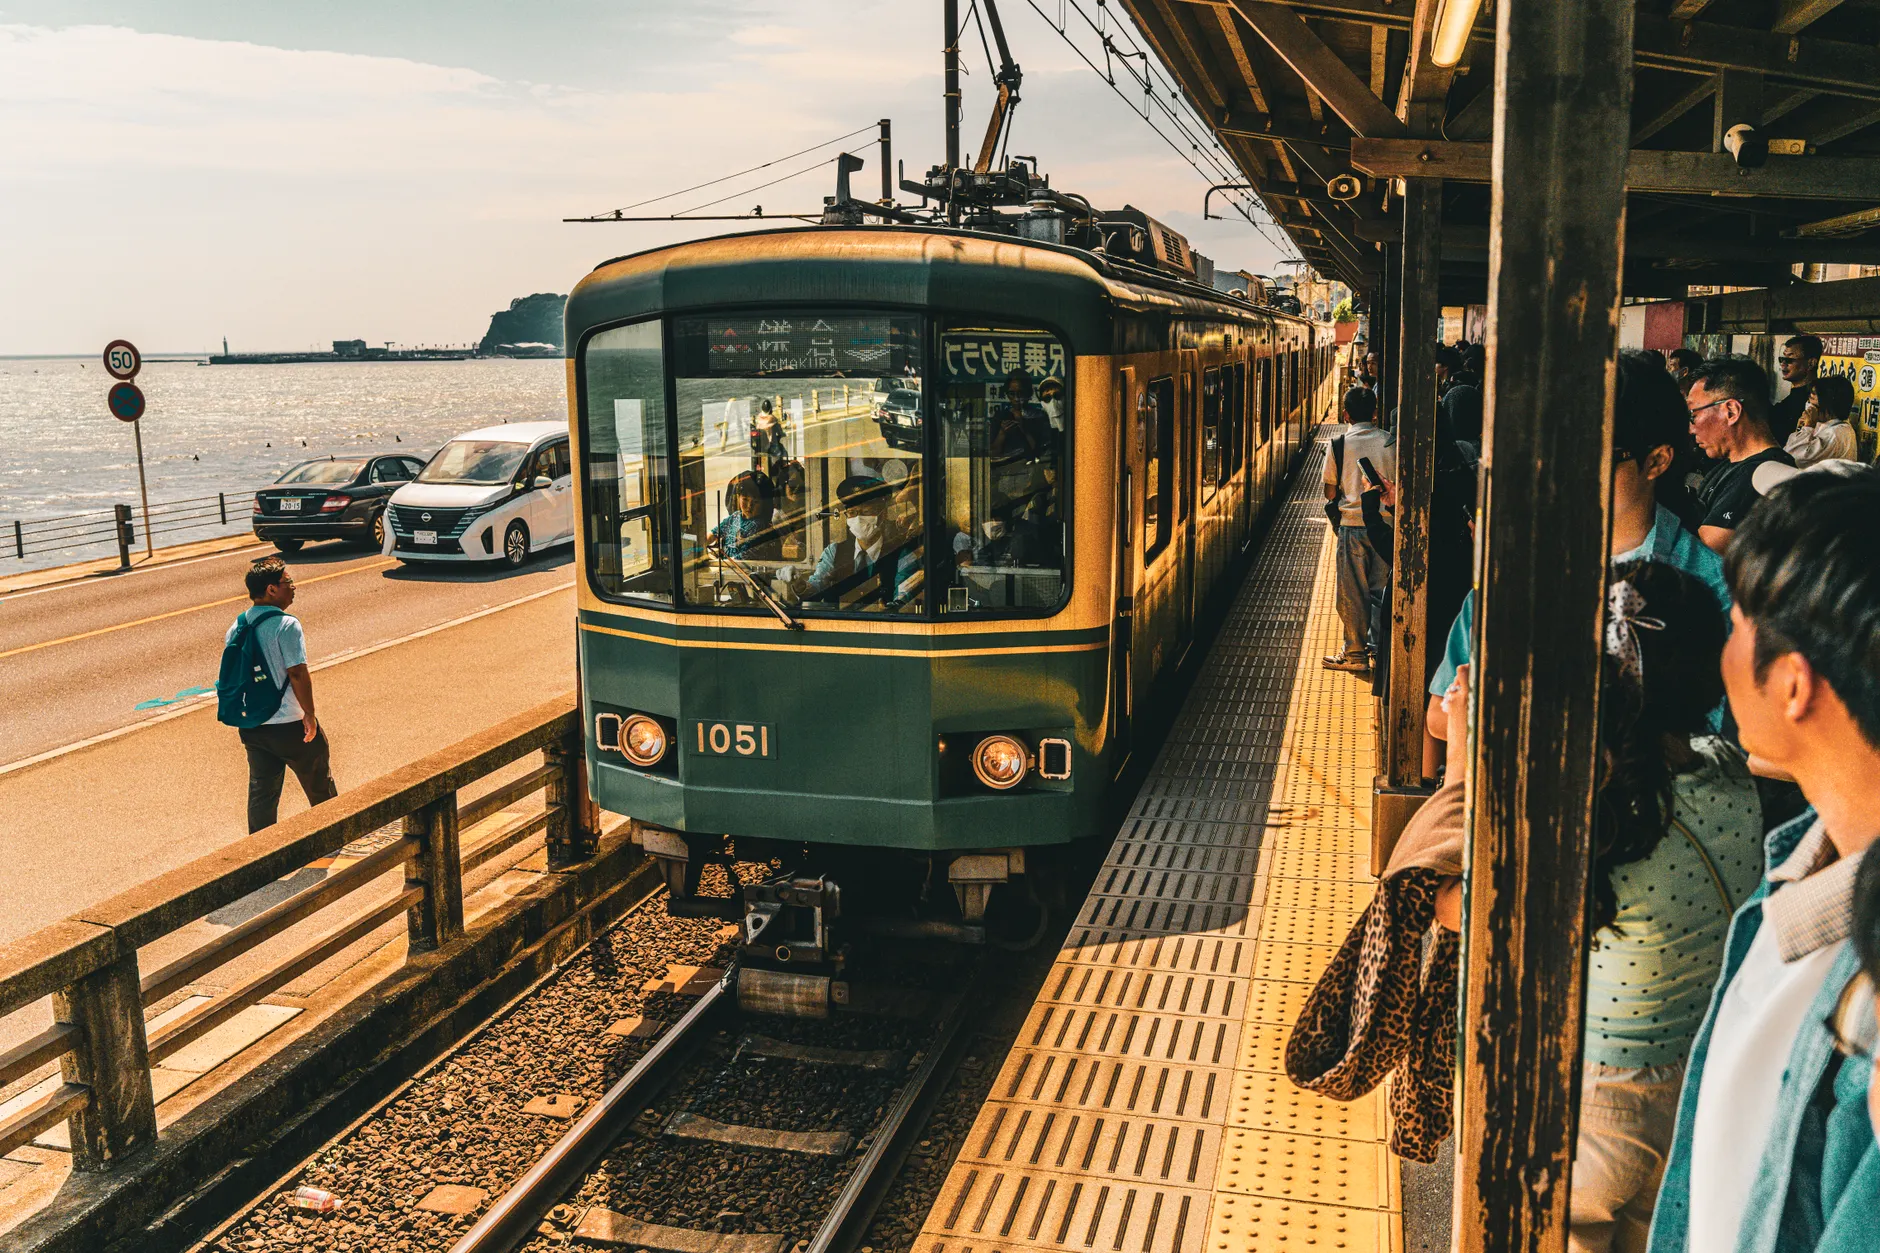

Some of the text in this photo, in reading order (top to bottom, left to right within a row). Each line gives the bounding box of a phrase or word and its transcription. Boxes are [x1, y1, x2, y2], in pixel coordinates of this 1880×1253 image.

[111, 351, 133, 369] 50
[759, 357, 838, 370] KAMAKURA
[697, 722, 768, 757] 1051
